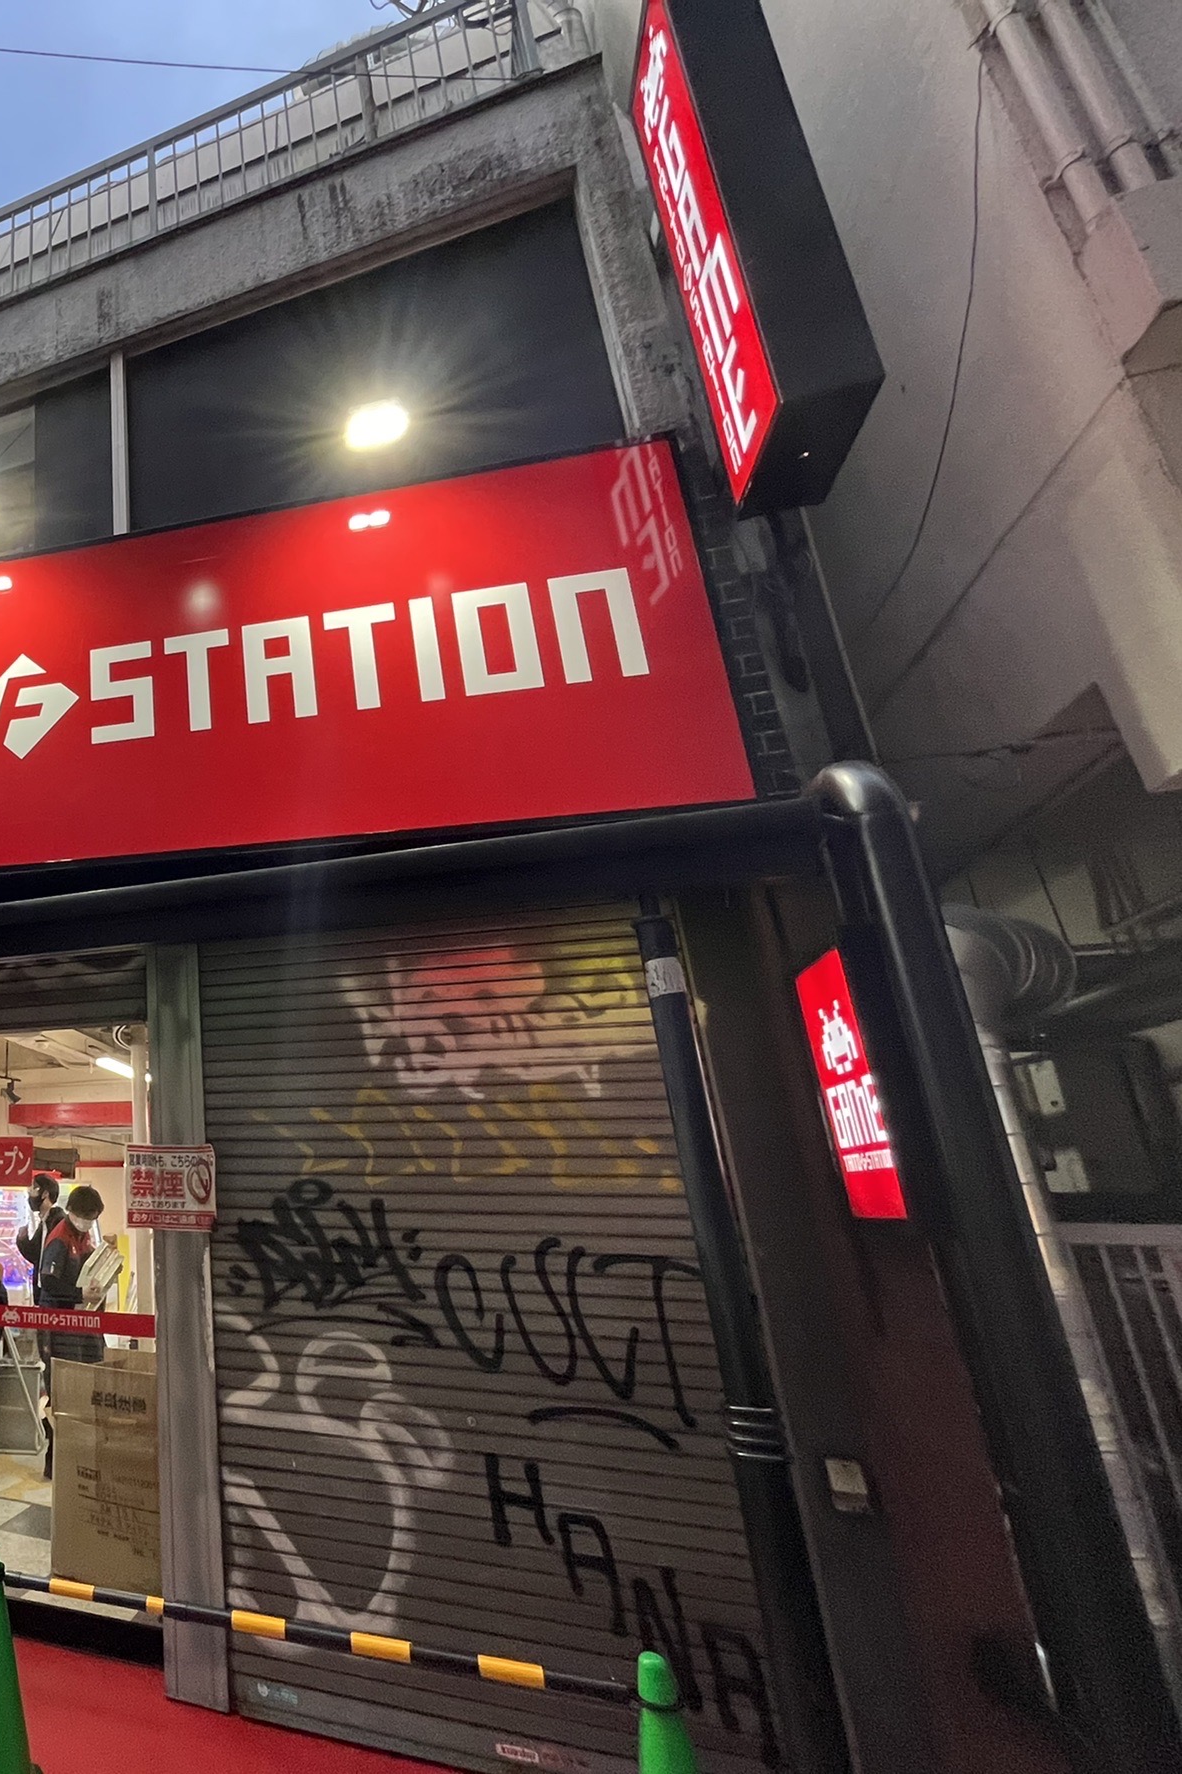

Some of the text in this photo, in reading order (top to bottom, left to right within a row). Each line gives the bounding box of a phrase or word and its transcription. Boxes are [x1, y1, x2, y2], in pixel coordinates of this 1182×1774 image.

[653, 146, 744, 475] TAITO STATION
[657, 94, 758, 454] GAME
[89, 567, 651, 745] STATION
[825, 1073, 889, 1149] GAME
[130, 1167, 186, 1199] 禁煙
[22, 1311, 101, 1329] TAITO STATION
